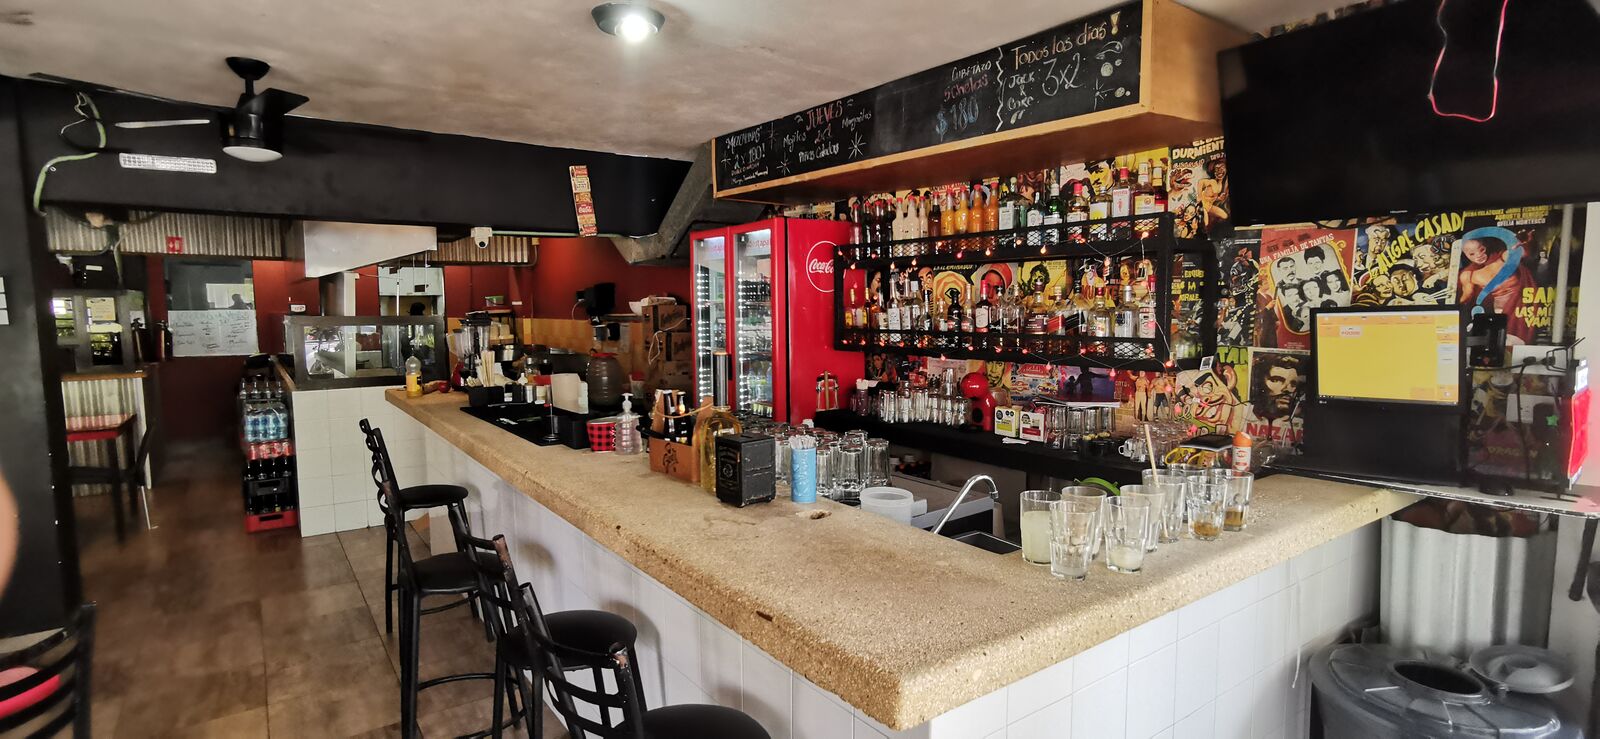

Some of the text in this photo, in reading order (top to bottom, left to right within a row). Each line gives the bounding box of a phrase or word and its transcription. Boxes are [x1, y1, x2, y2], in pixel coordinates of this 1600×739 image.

[1011, 45, 1049, 70] Todos
[1052, 36, 1073, 54] los
[1041, 52, 1085, 97] 3x2
[806, 100, 844, 131] JUEVES
[1300, 241, 1309, 250] DE
[1309, 233, 1335, 247] TANTAS
